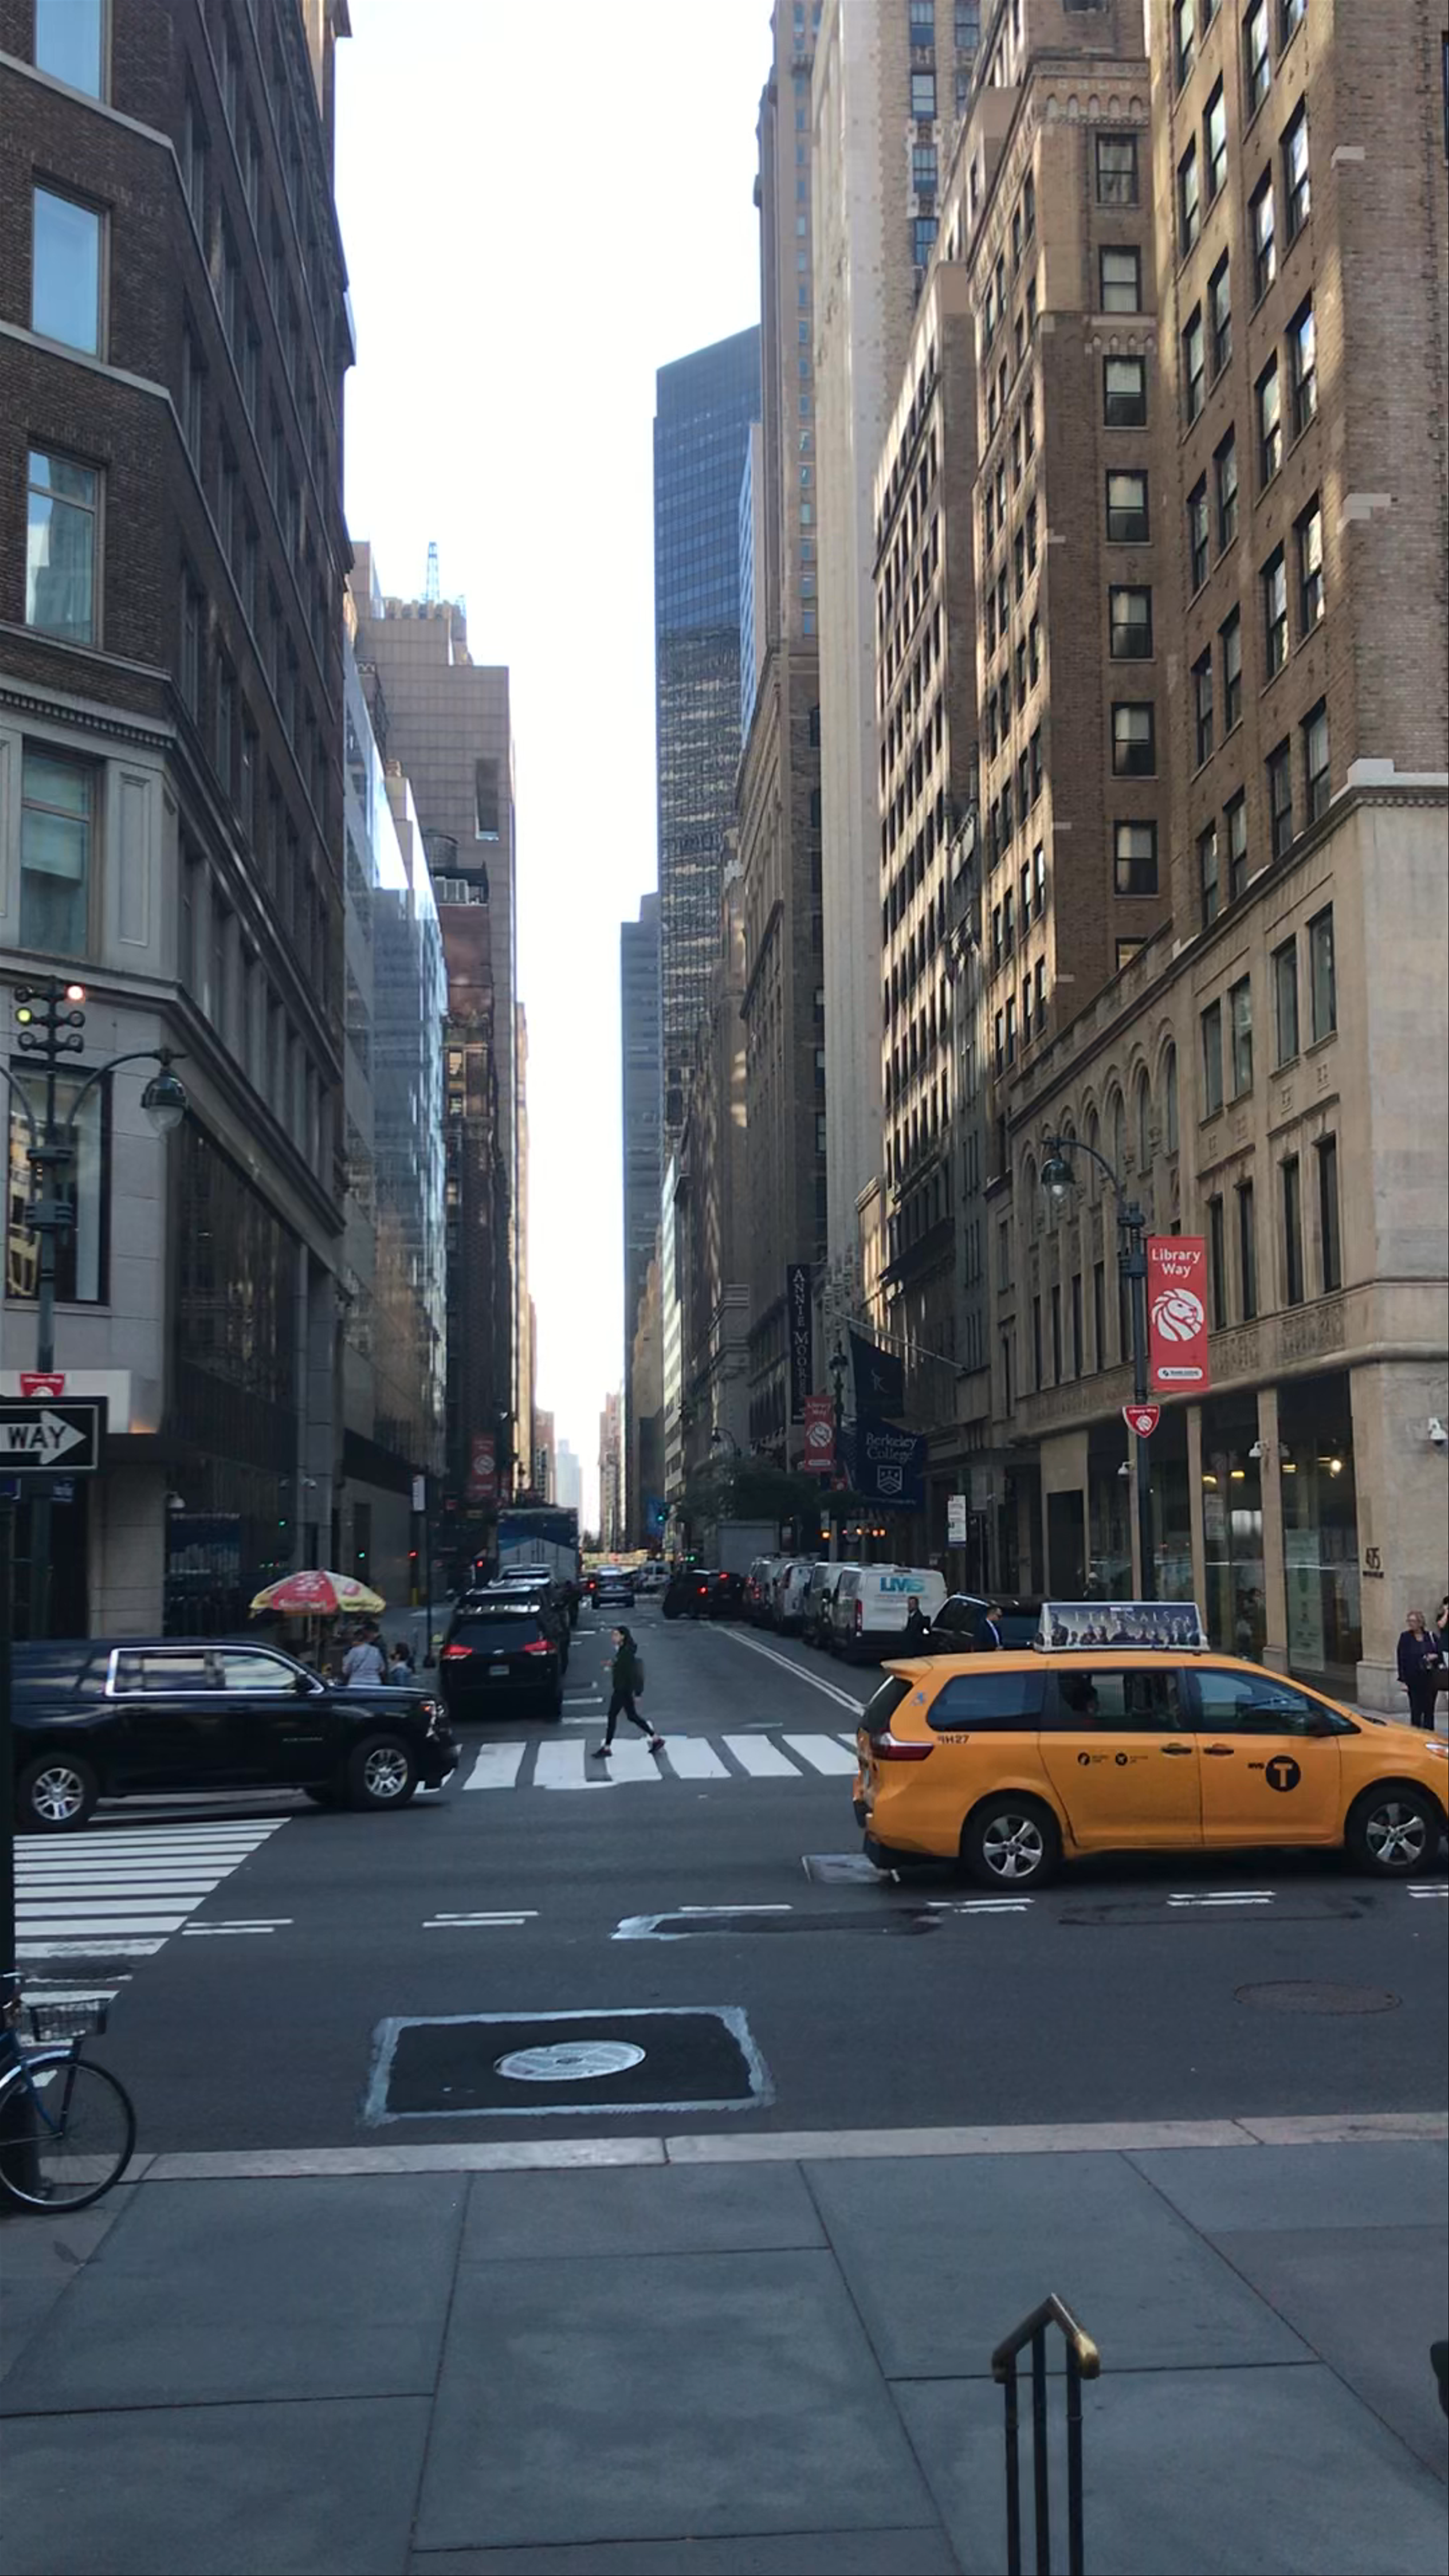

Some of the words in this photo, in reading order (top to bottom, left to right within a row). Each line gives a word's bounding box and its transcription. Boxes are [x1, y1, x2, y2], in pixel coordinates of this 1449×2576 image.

[1152, 1249, 1201, 1263] Library
[1162, 1263, 1191, 1278] Way
[794, 1269, 805, 1327] ANNIE
[8, 1426, 66, 1449] WAY
[866, 1433, 917, 1450] Berkeley
[867, 1447, 913, 1463] College
[1075, 1611, 1169, 1622] ETERNALS
[1274, 1763, 1292, 1787] T
